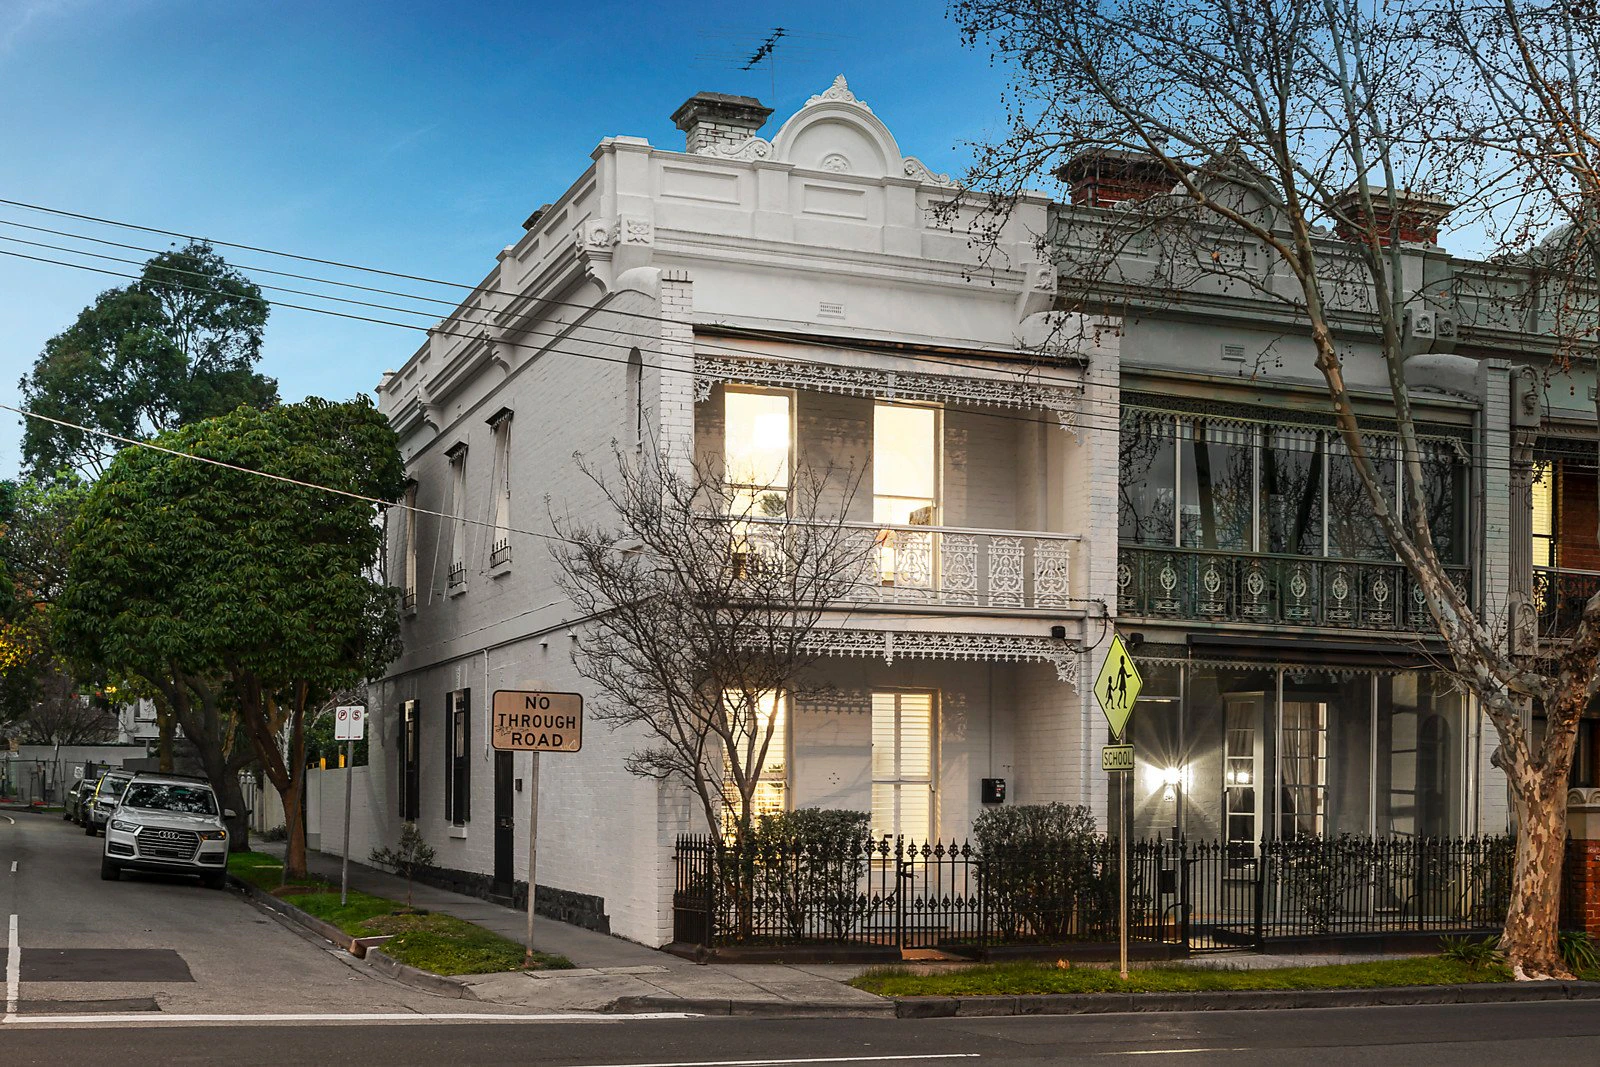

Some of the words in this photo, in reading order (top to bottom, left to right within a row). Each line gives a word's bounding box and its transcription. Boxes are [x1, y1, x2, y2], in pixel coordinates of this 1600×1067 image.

[525, 696, 550, 710] NO
[498, 713, 576, 729] THROUGH
[511, 732, 563, 747] ROAD
[1103, 751, 1133, 766] SCHOOL
